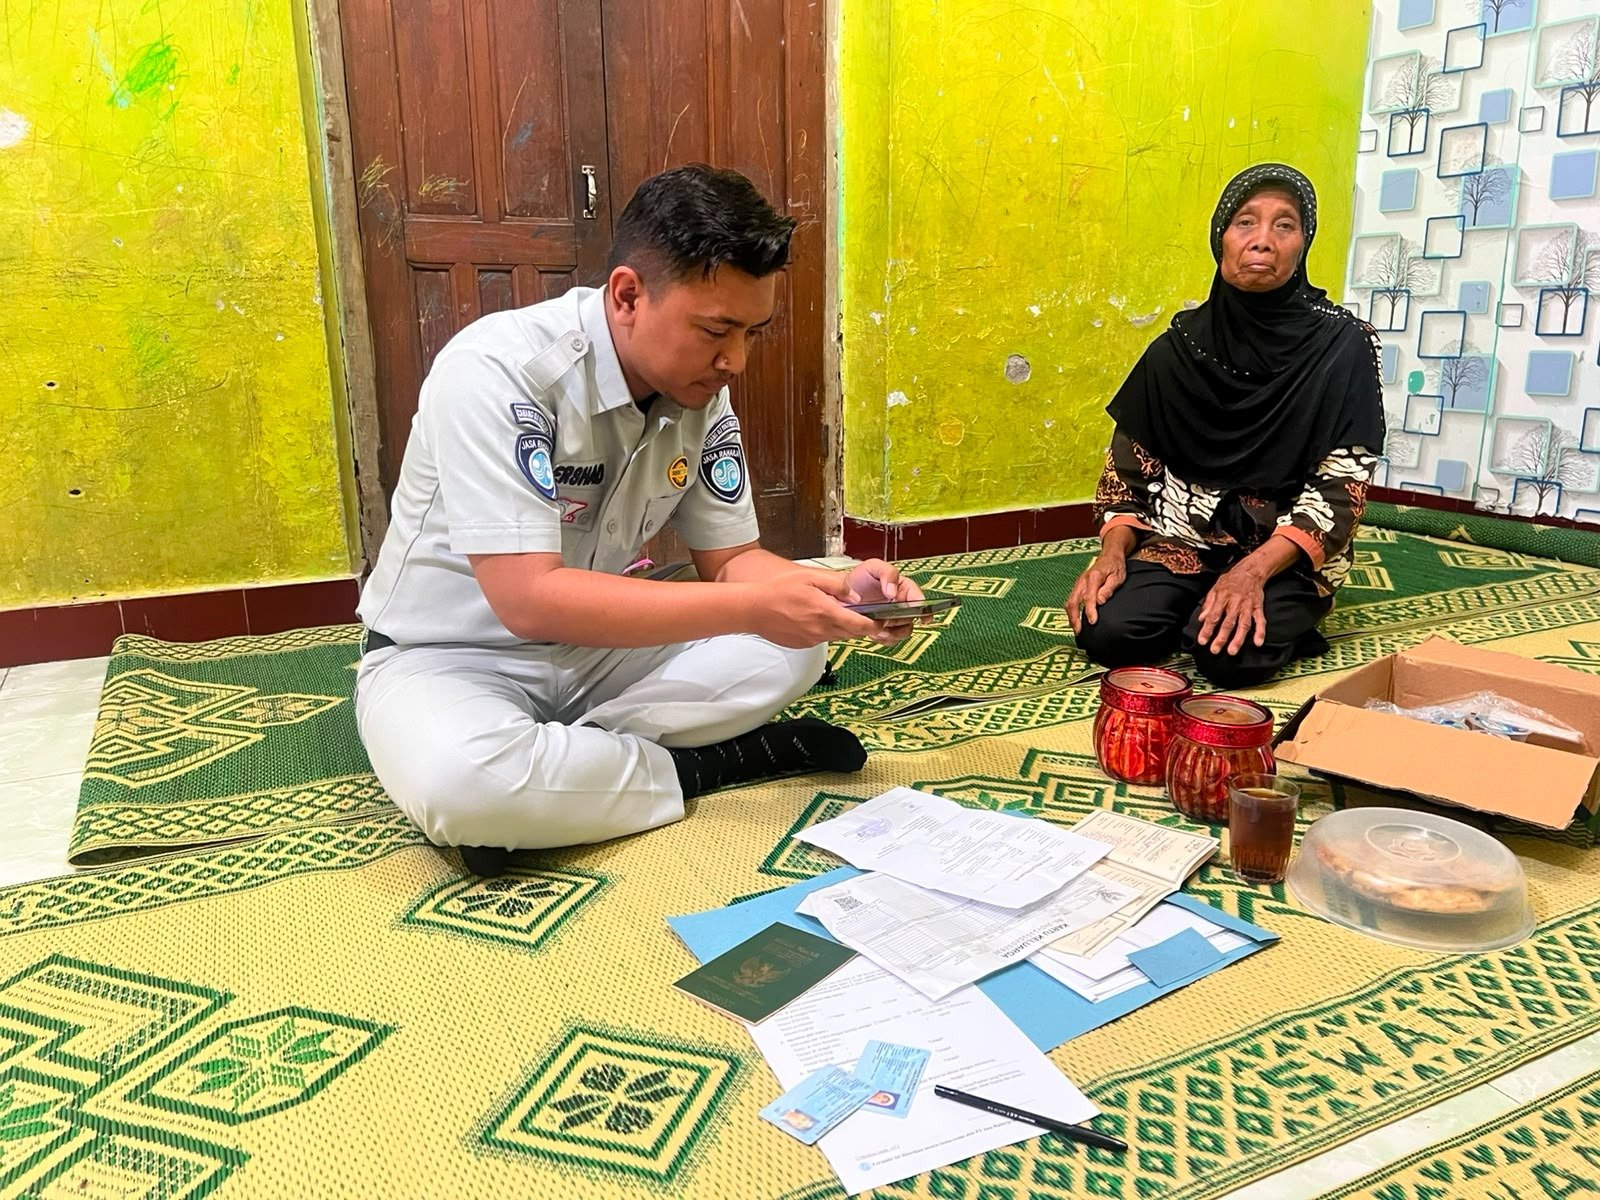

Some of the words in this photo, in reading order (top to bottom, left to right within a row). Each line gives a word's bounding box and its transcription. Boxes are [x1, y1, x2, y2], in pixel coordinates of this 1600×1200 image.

[521, 439, 537, 451] JASA
[702, 452, 719, 465] JASA
[1042, 922, 1070, 937] KARTU
[1000, 933, 1043, 959] KELUARGA
